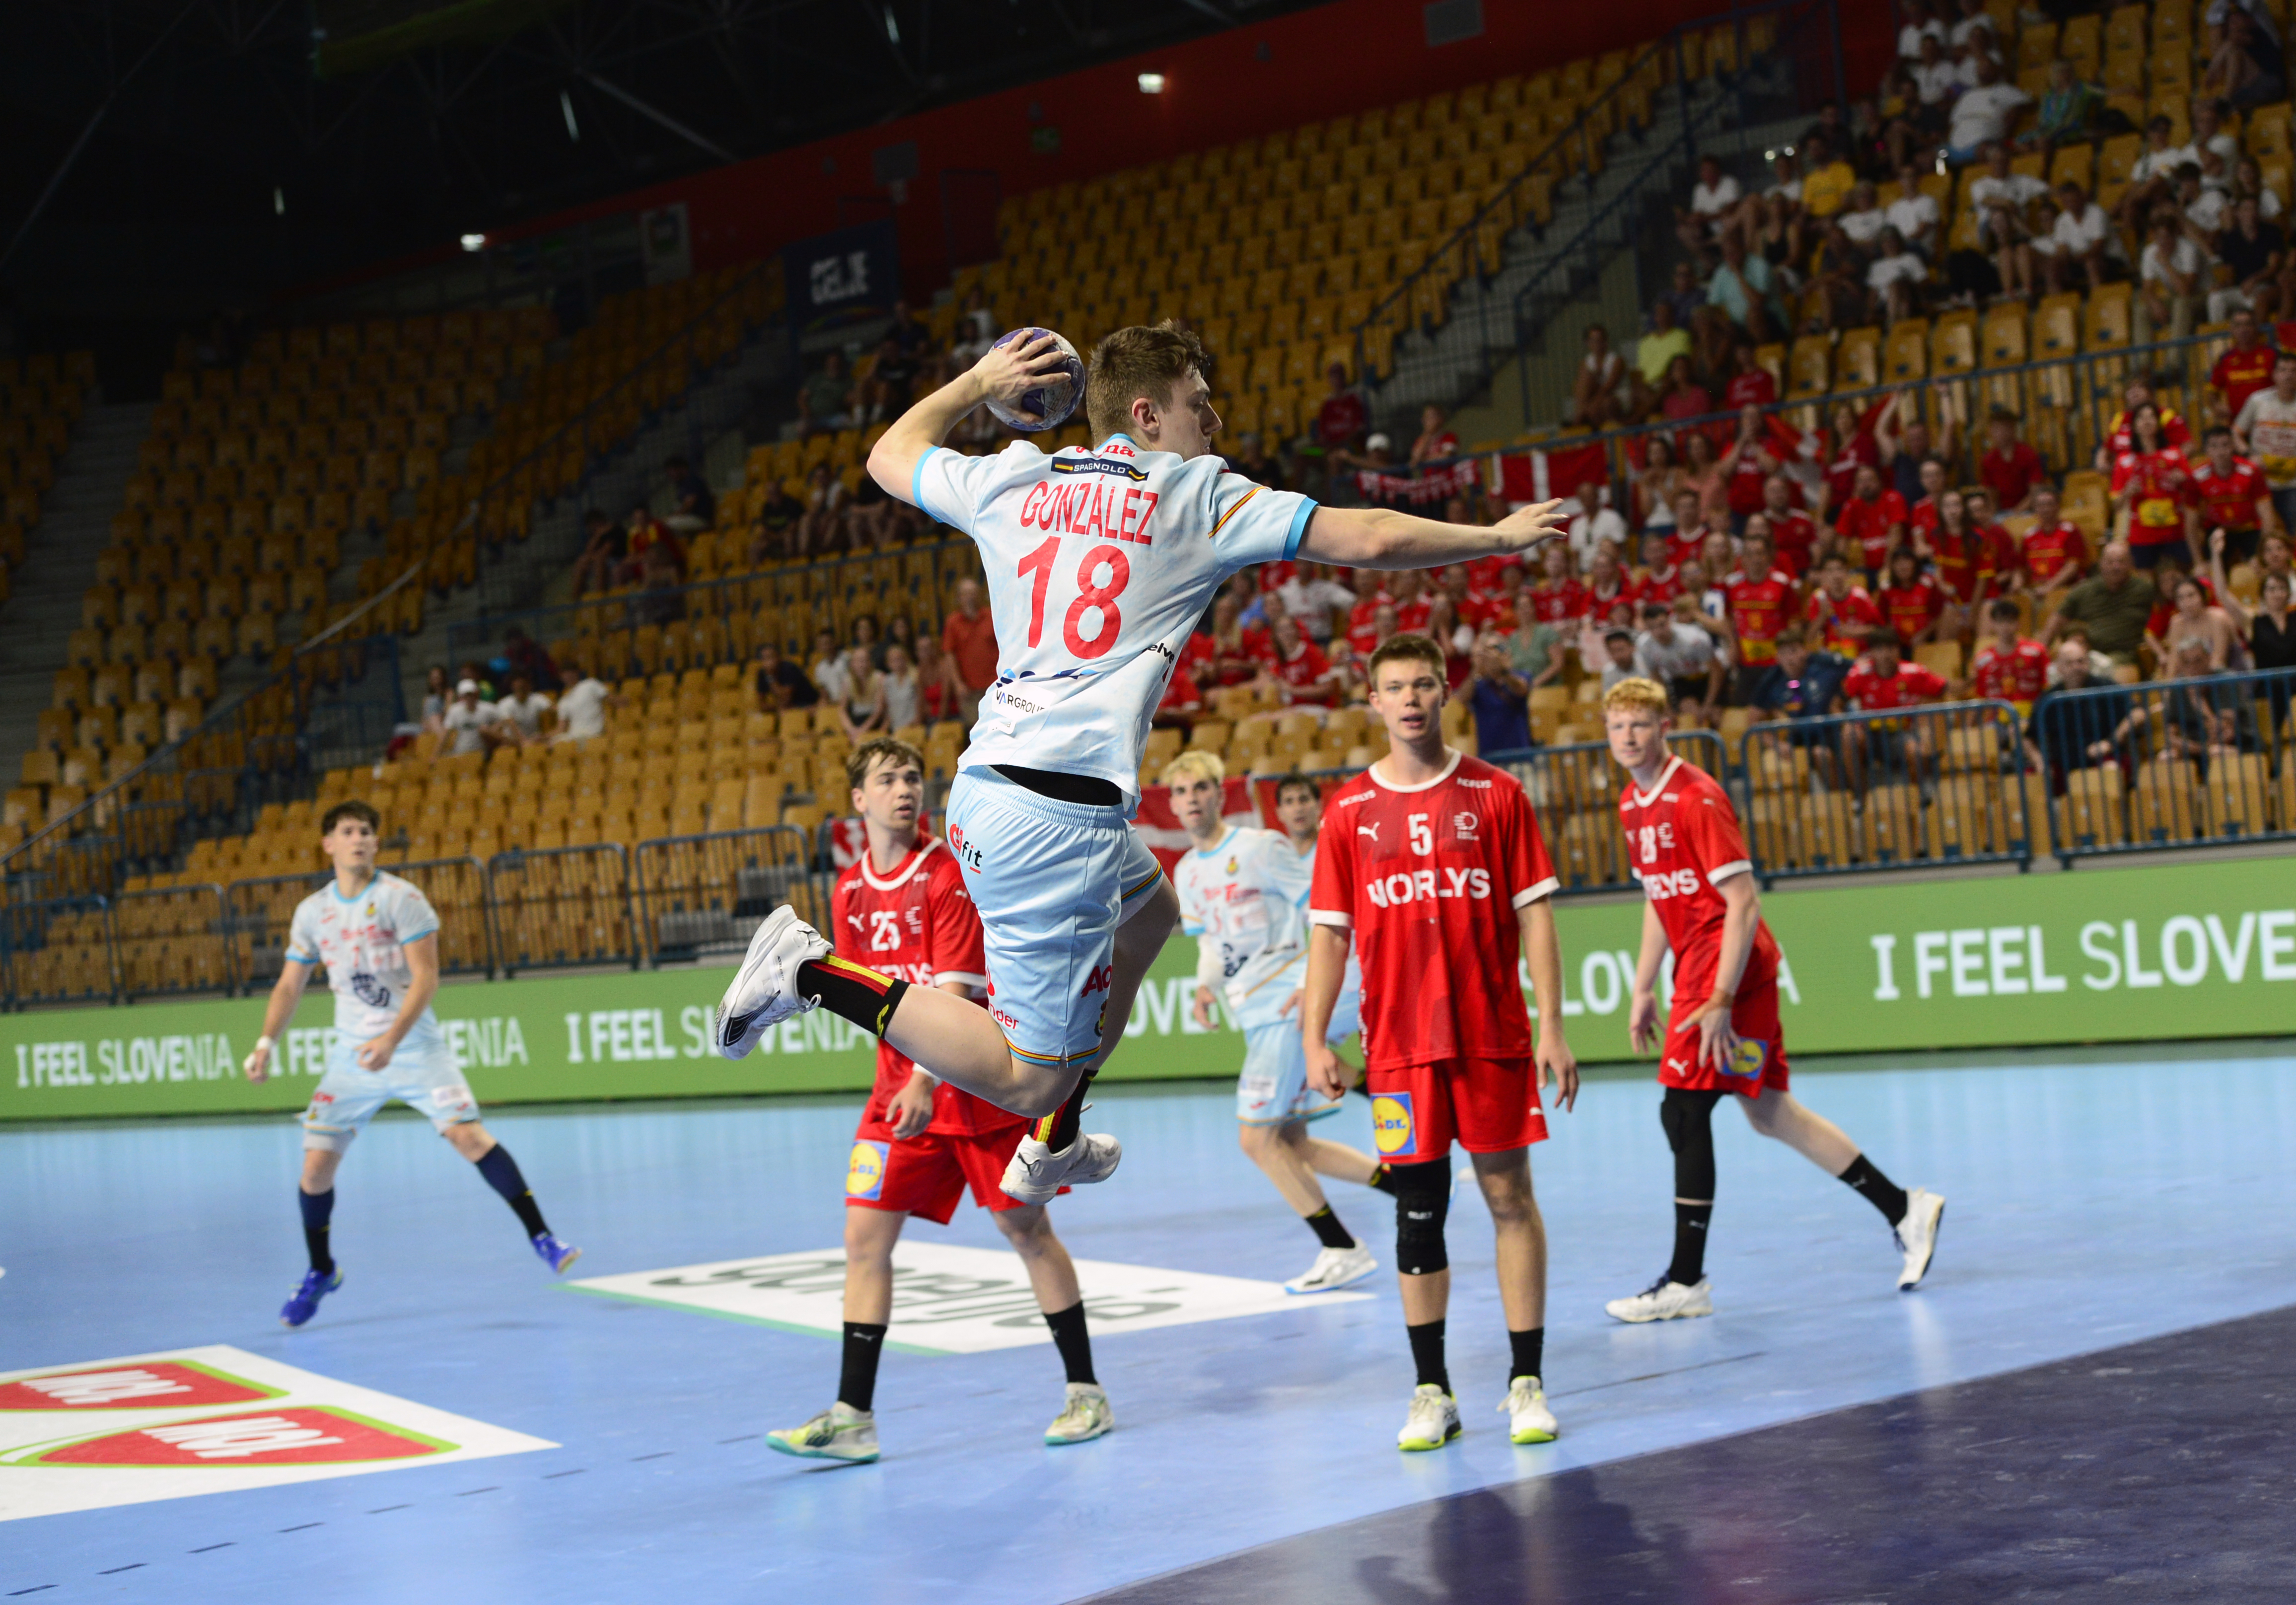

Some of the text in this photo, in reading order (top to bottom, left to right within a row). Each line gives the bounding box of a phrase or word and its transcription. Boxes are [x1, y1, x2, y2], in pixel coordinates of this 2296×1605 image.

[1074, 462, 1126, 474] SPAGNOLO
[1019, 474, 1159, 545] GONZÁLEZ
[1017, 535, 1131, 660] 18
[1407, 812, 1434, 857] 5
[1366, 867, 1491, 909] NORLYS
[1870, 934, 1900, 1002] I
[1914, 925, 2067, 999] FEEL
[15, 1033, 237, 1088] I FEEL SLOVENIA
[565, 1012, 584, 1064] I
[589, 1008, 676, 1062] FEEL
[139, 1416, 345, 1459] MOL
